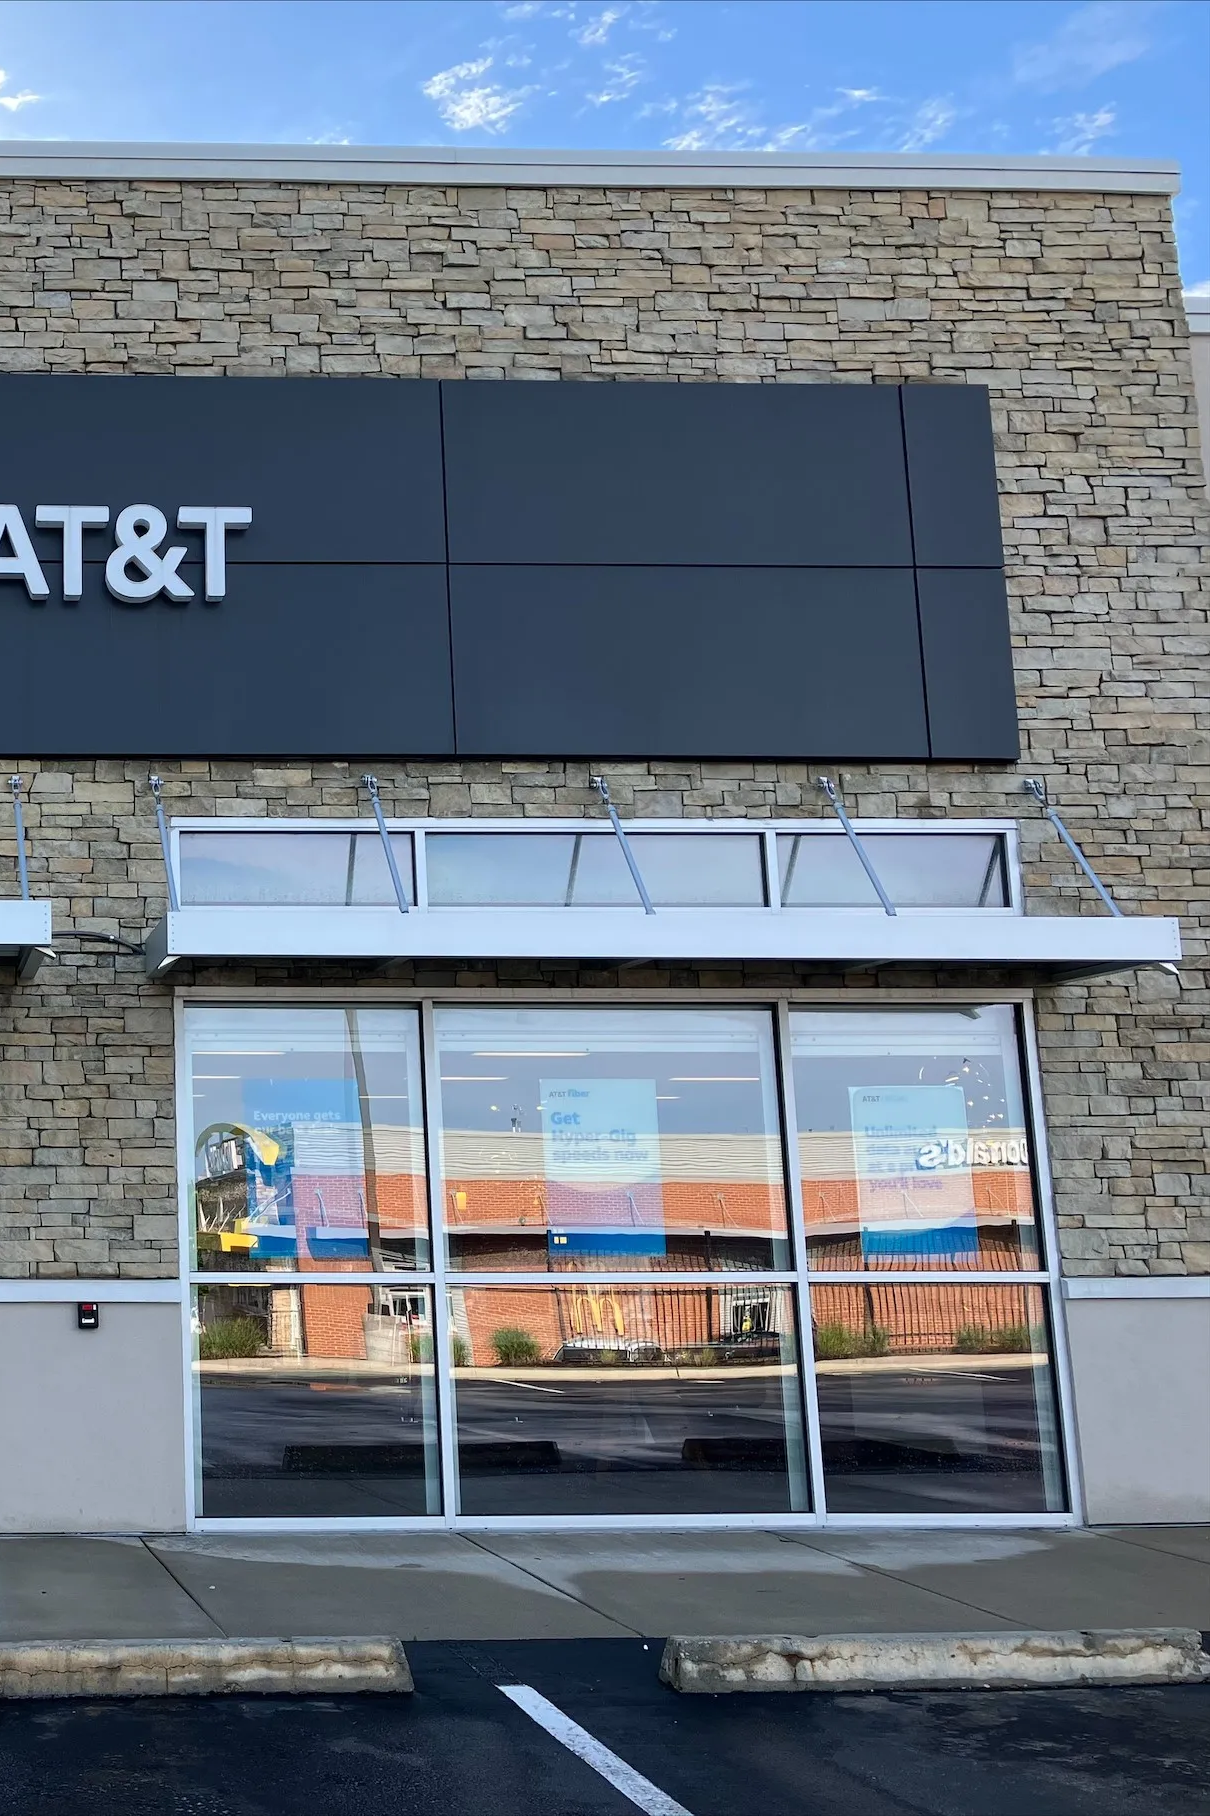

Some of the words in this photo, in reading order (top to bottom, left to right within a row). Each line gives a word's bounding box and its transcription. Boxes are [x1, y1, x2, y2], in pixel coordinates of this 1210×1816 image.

[862, 1095, 880, 1103] AT&T
[253, 1111, 311, 1123] Everyone
[314, 1110, 342, 1123] gets
[551, 1111, 581, 1125] Get
